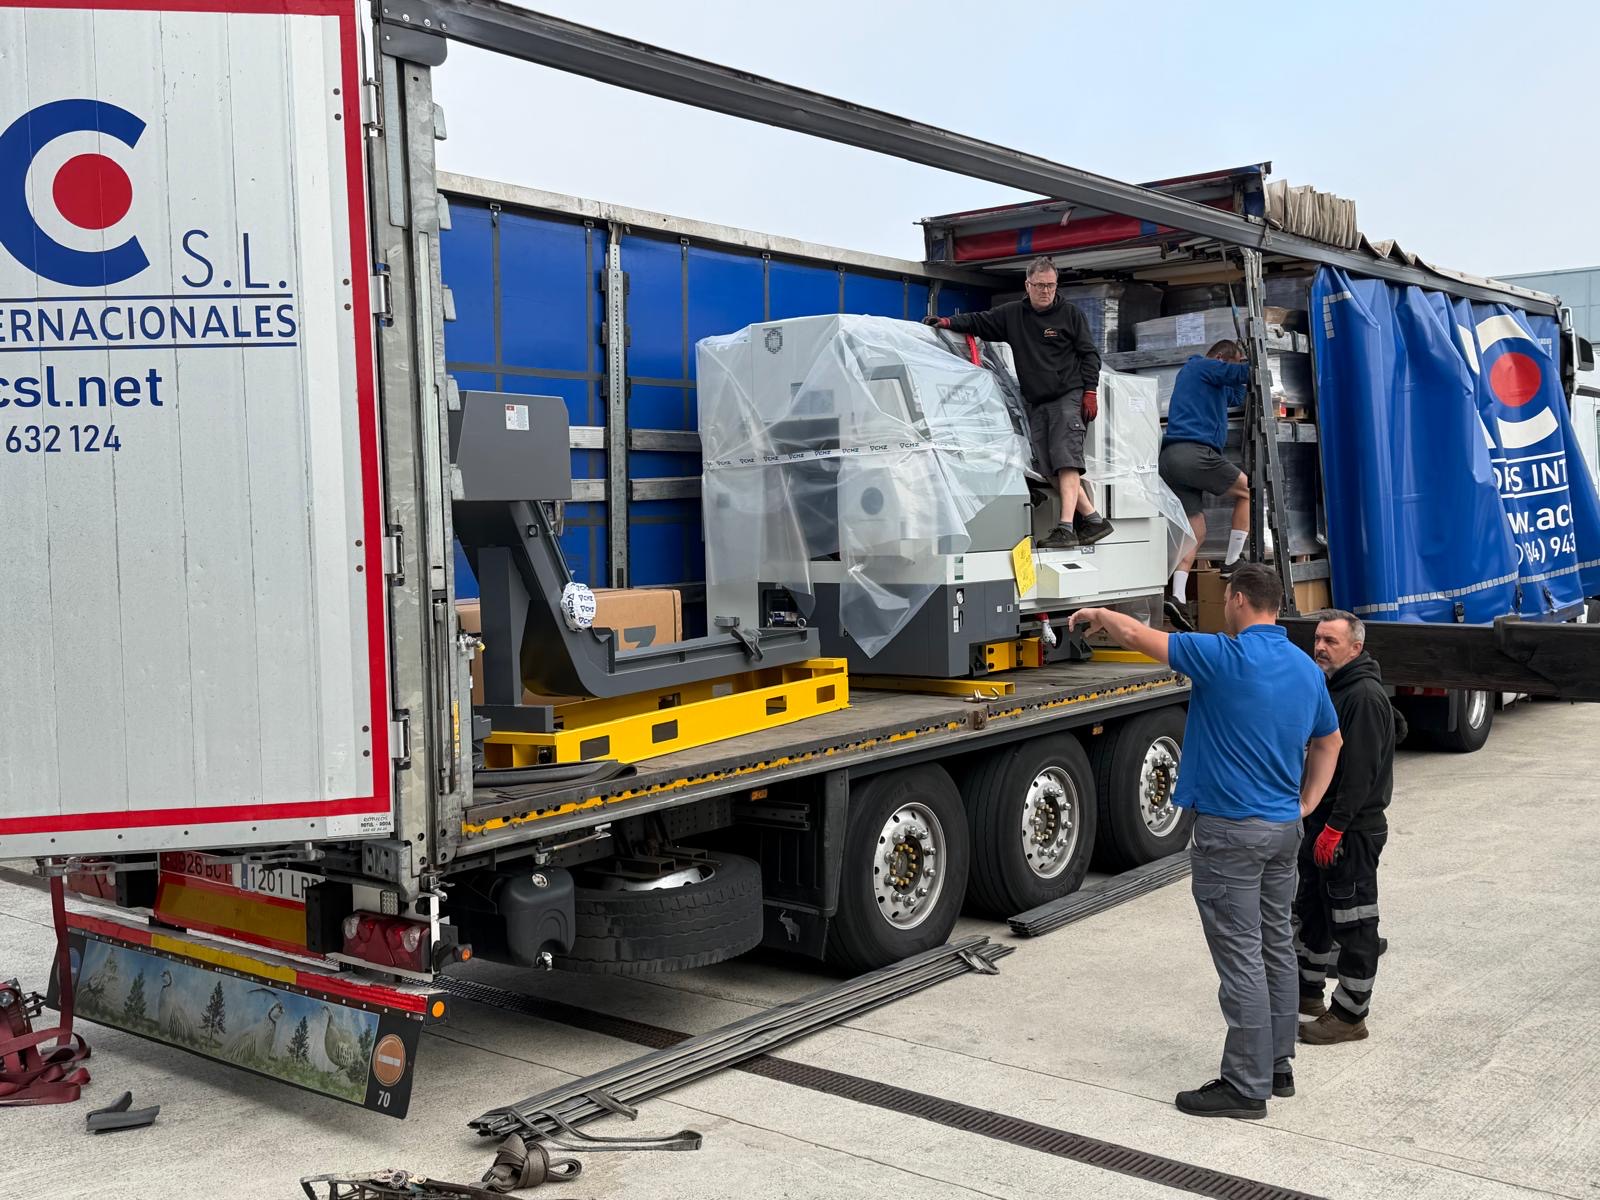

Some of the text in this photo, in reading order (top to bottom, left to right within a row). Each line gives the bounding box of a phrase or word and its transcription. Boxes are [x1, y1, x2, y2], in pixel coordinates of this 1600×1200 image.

[0, 99, 287, 288] C S.L.
[5, 425, 121, 453] 632 124
[250, 866, 284, 895] 1201
[377, 1090, 391, 1108] 70
